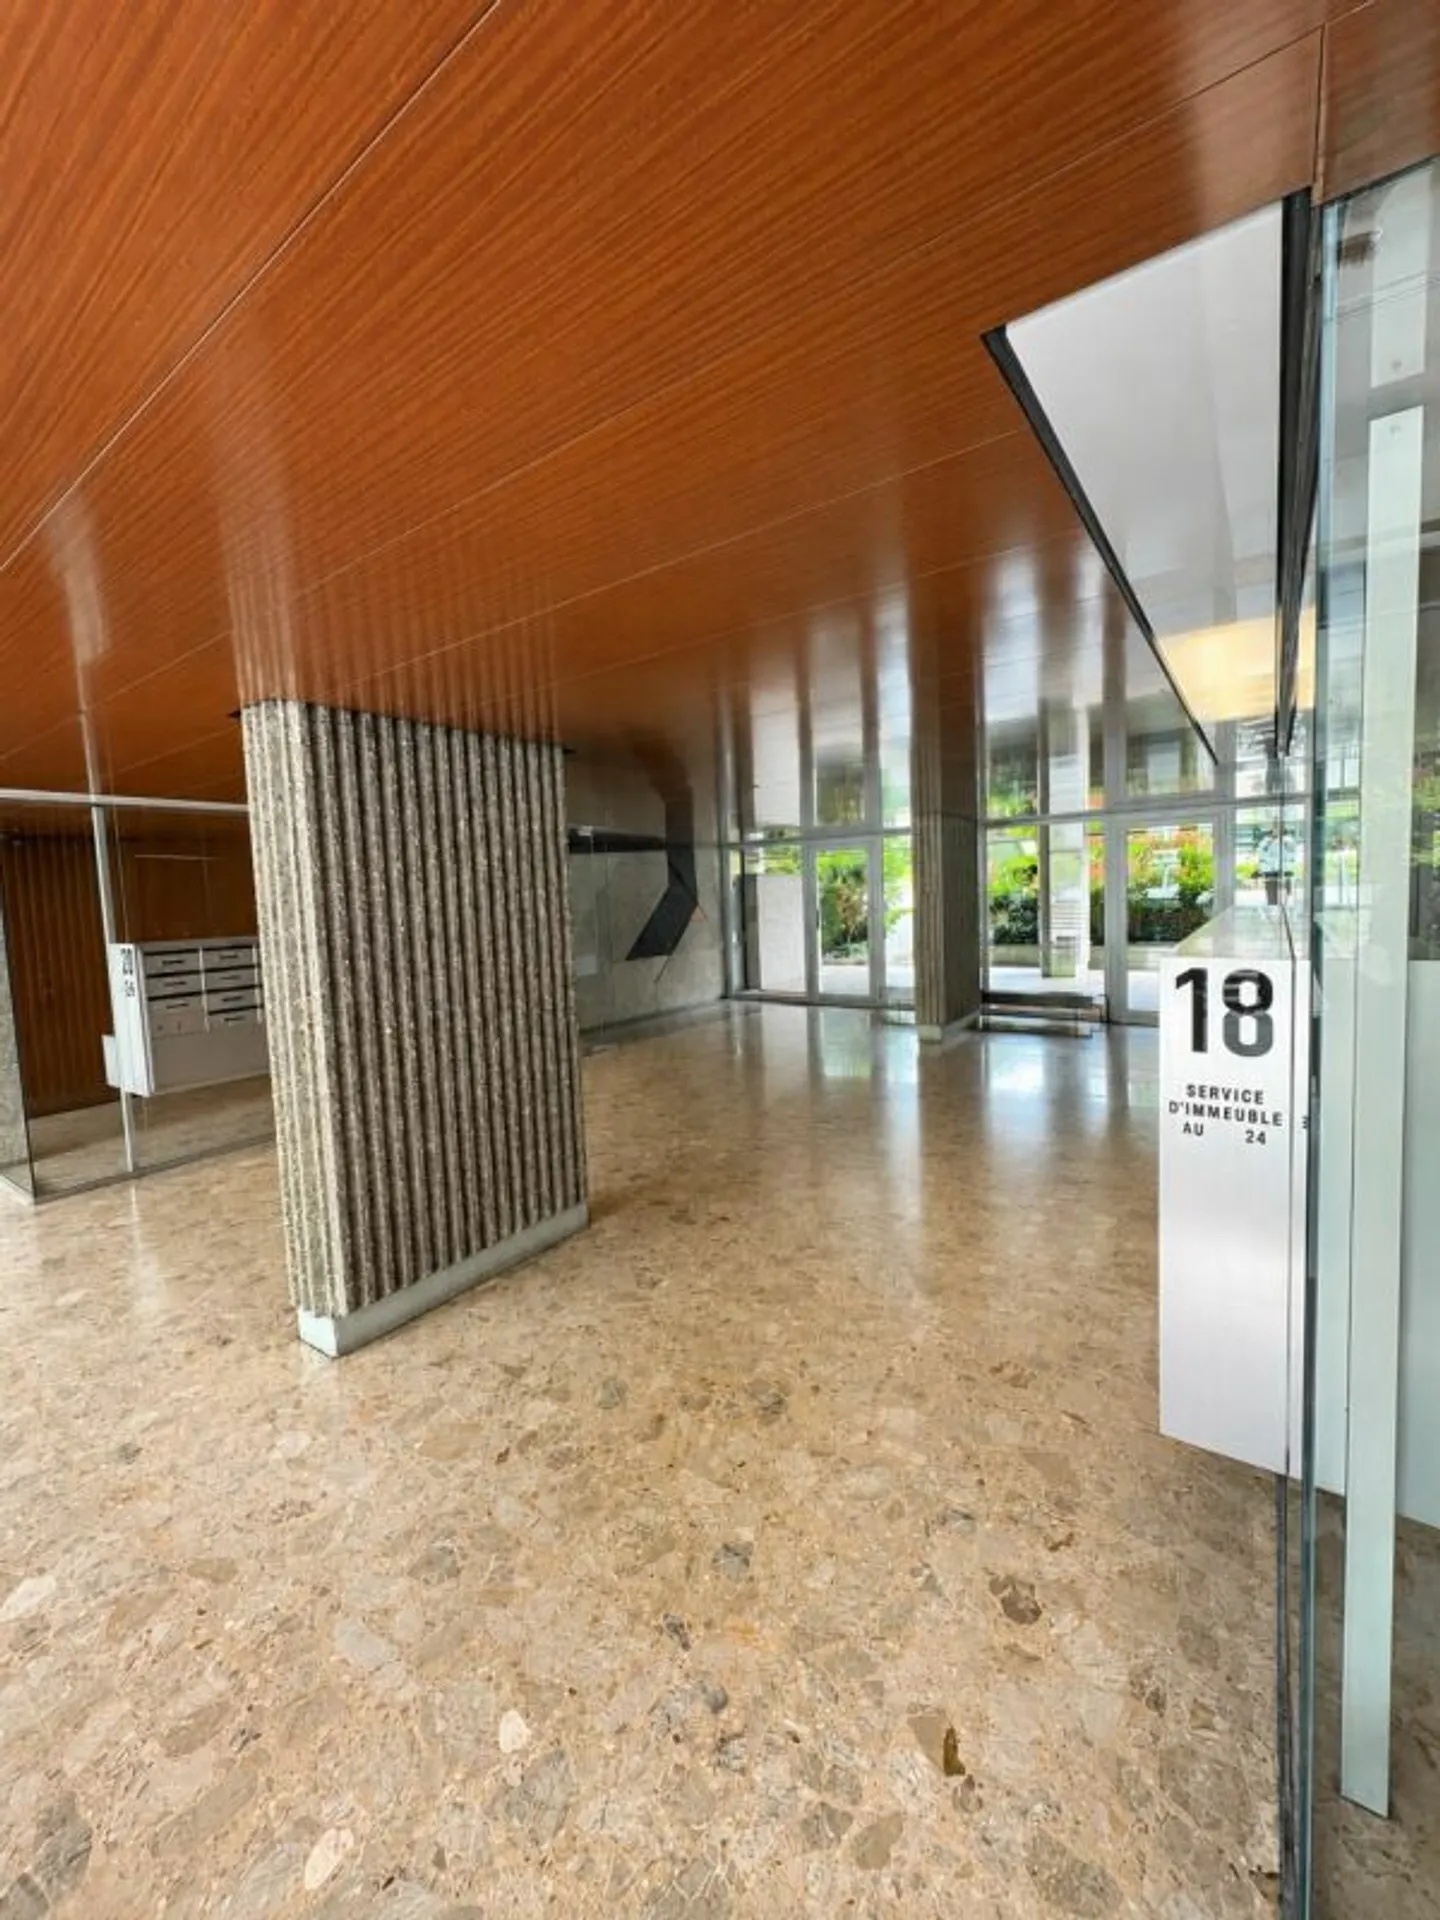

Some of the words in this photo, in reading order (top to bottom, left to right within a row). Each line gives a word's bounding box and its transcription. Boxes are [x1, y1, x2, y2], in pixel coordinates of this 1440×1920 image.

[1175, 967, 1274, 1058] 18
[1186, 1084, 1264, 1105] SERVICE
[1168, 1101, 1283, 1126] D'IMMEUBLE
[1182, 1122, 1205, 1137] AU
[1245, 1130, 1267, 1145] 24
